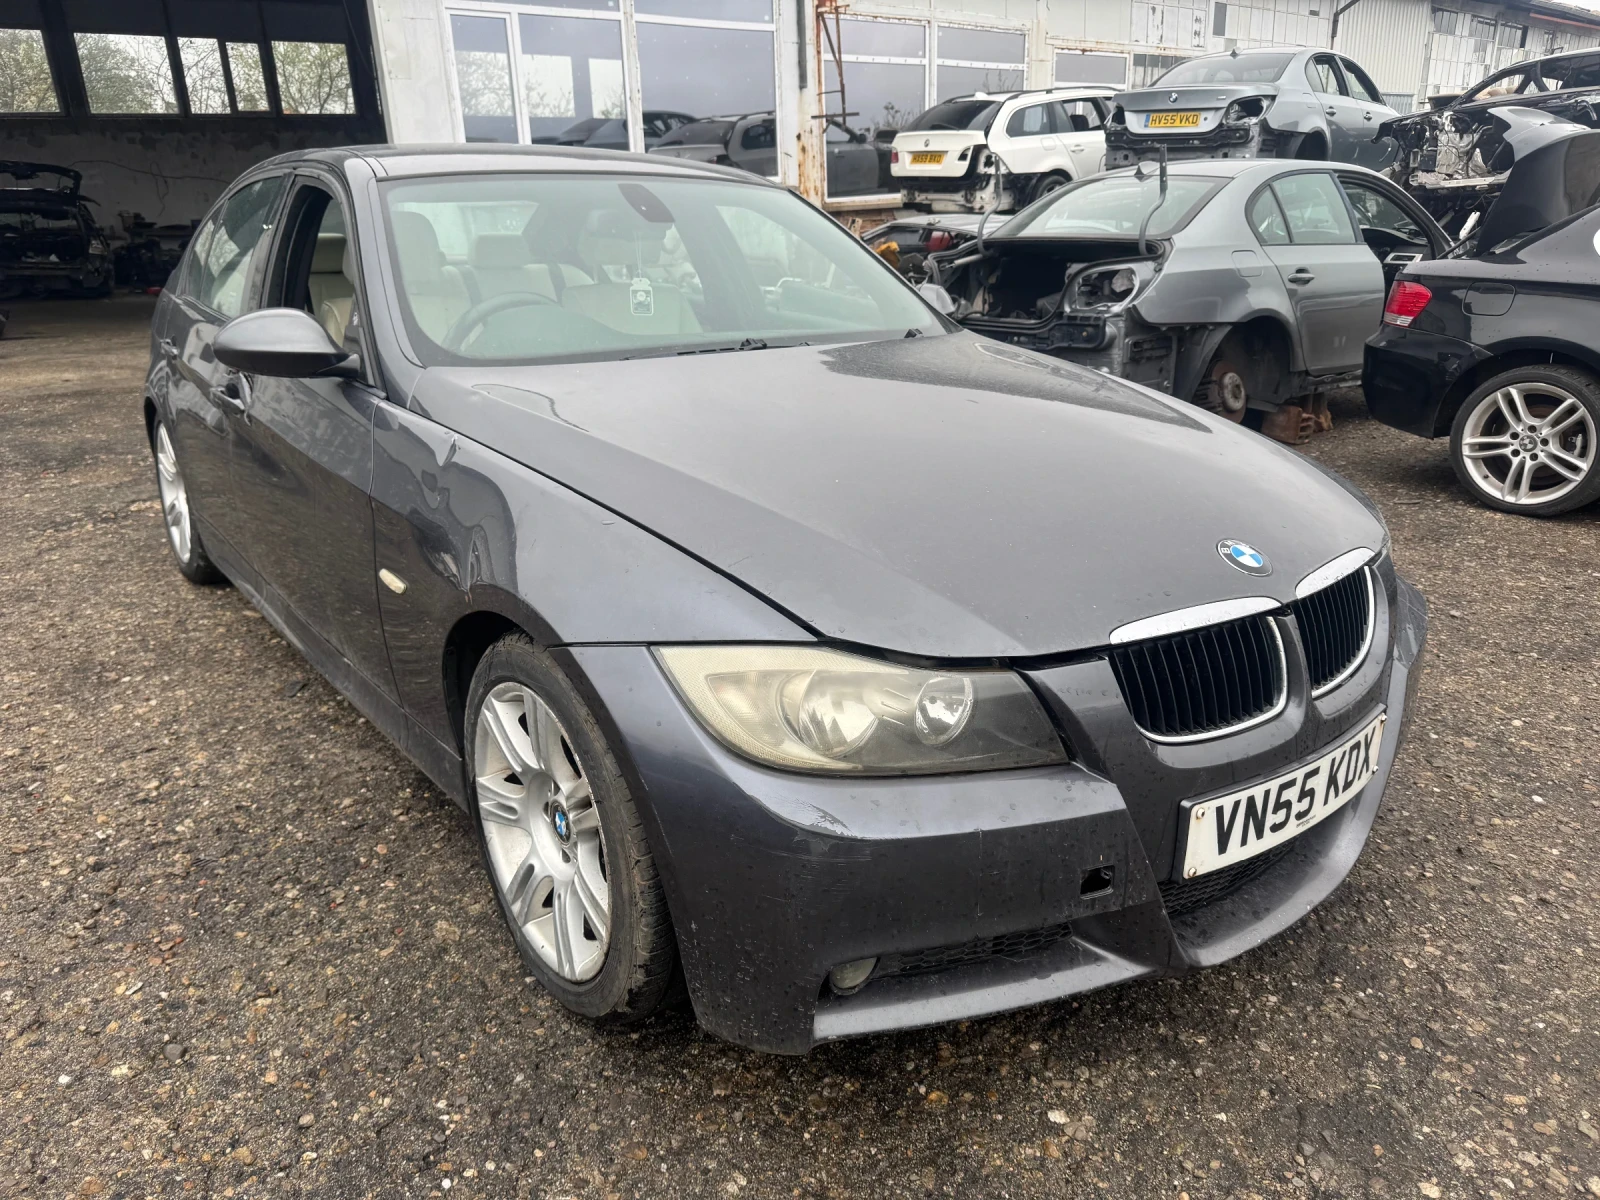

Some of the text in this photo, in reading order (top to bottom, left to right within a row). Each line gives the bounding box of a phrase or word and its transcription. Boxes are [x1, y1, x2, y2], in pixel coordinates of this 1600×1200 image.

[1150, 114, 1199, 126] HV55 VKD
[1215, 725, 1377, 856] VN55 KDX
